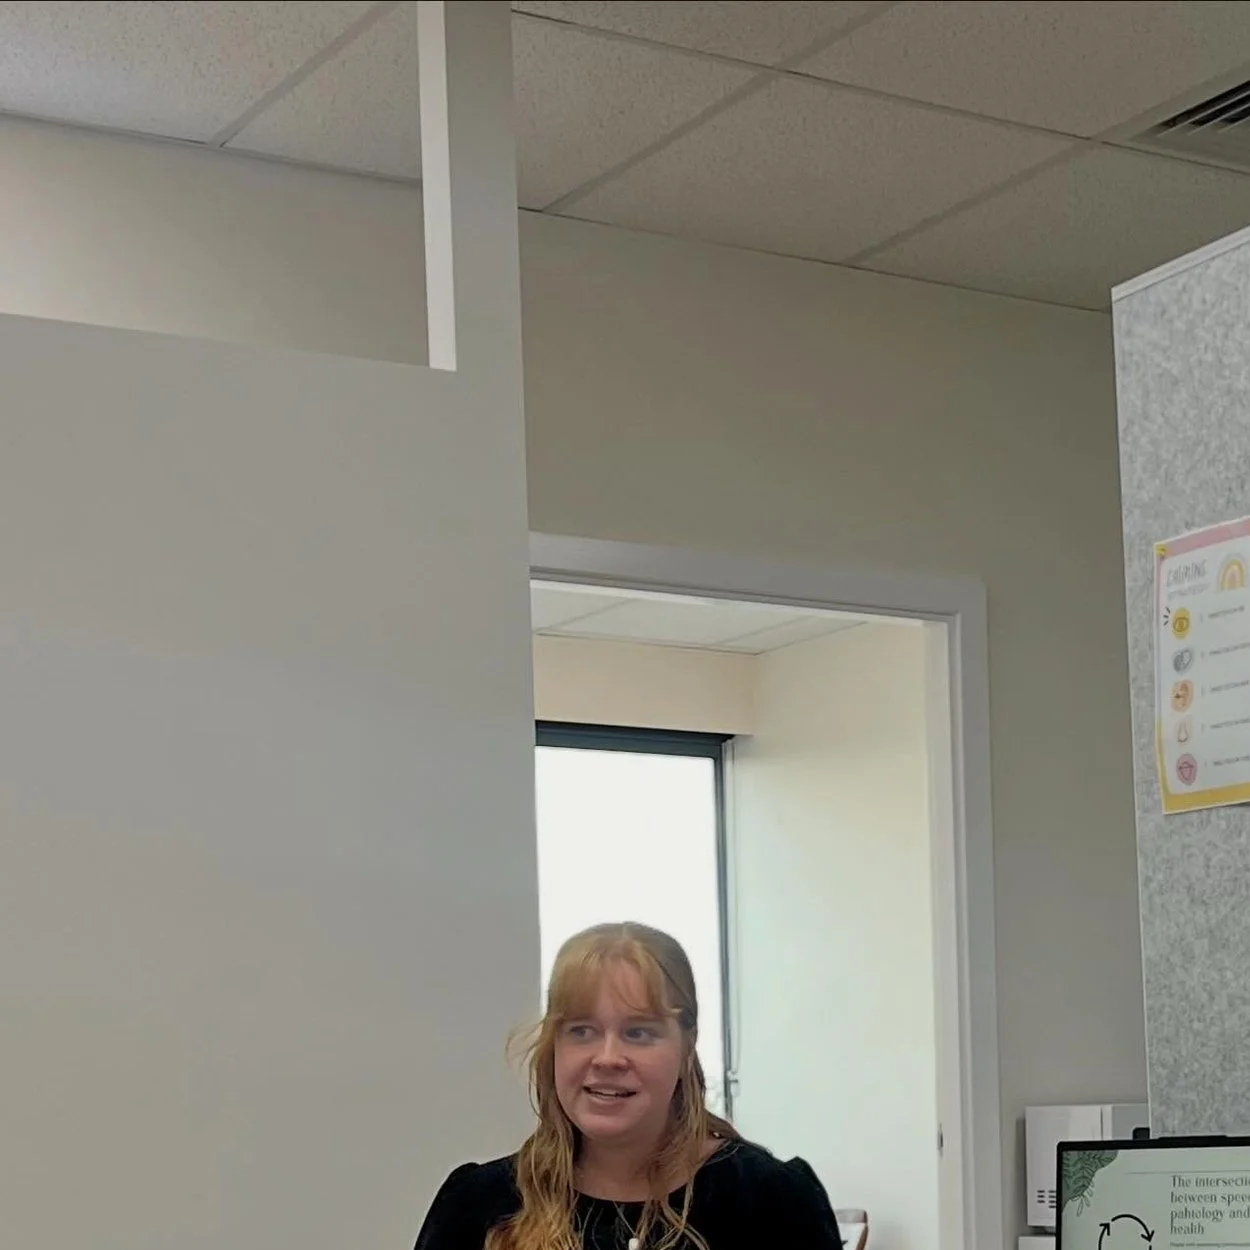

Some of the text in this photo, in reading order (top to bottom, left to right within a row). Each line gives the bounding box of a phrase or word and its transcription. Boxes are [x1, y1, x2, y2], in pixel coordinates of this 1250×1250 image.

[1170, 1174, 1191, 1189] The
[1170, 1191, 1217, 1204] between
[1229, 1207, 1250, 1219] and
[1170, 1222, 1205, 1235] health
